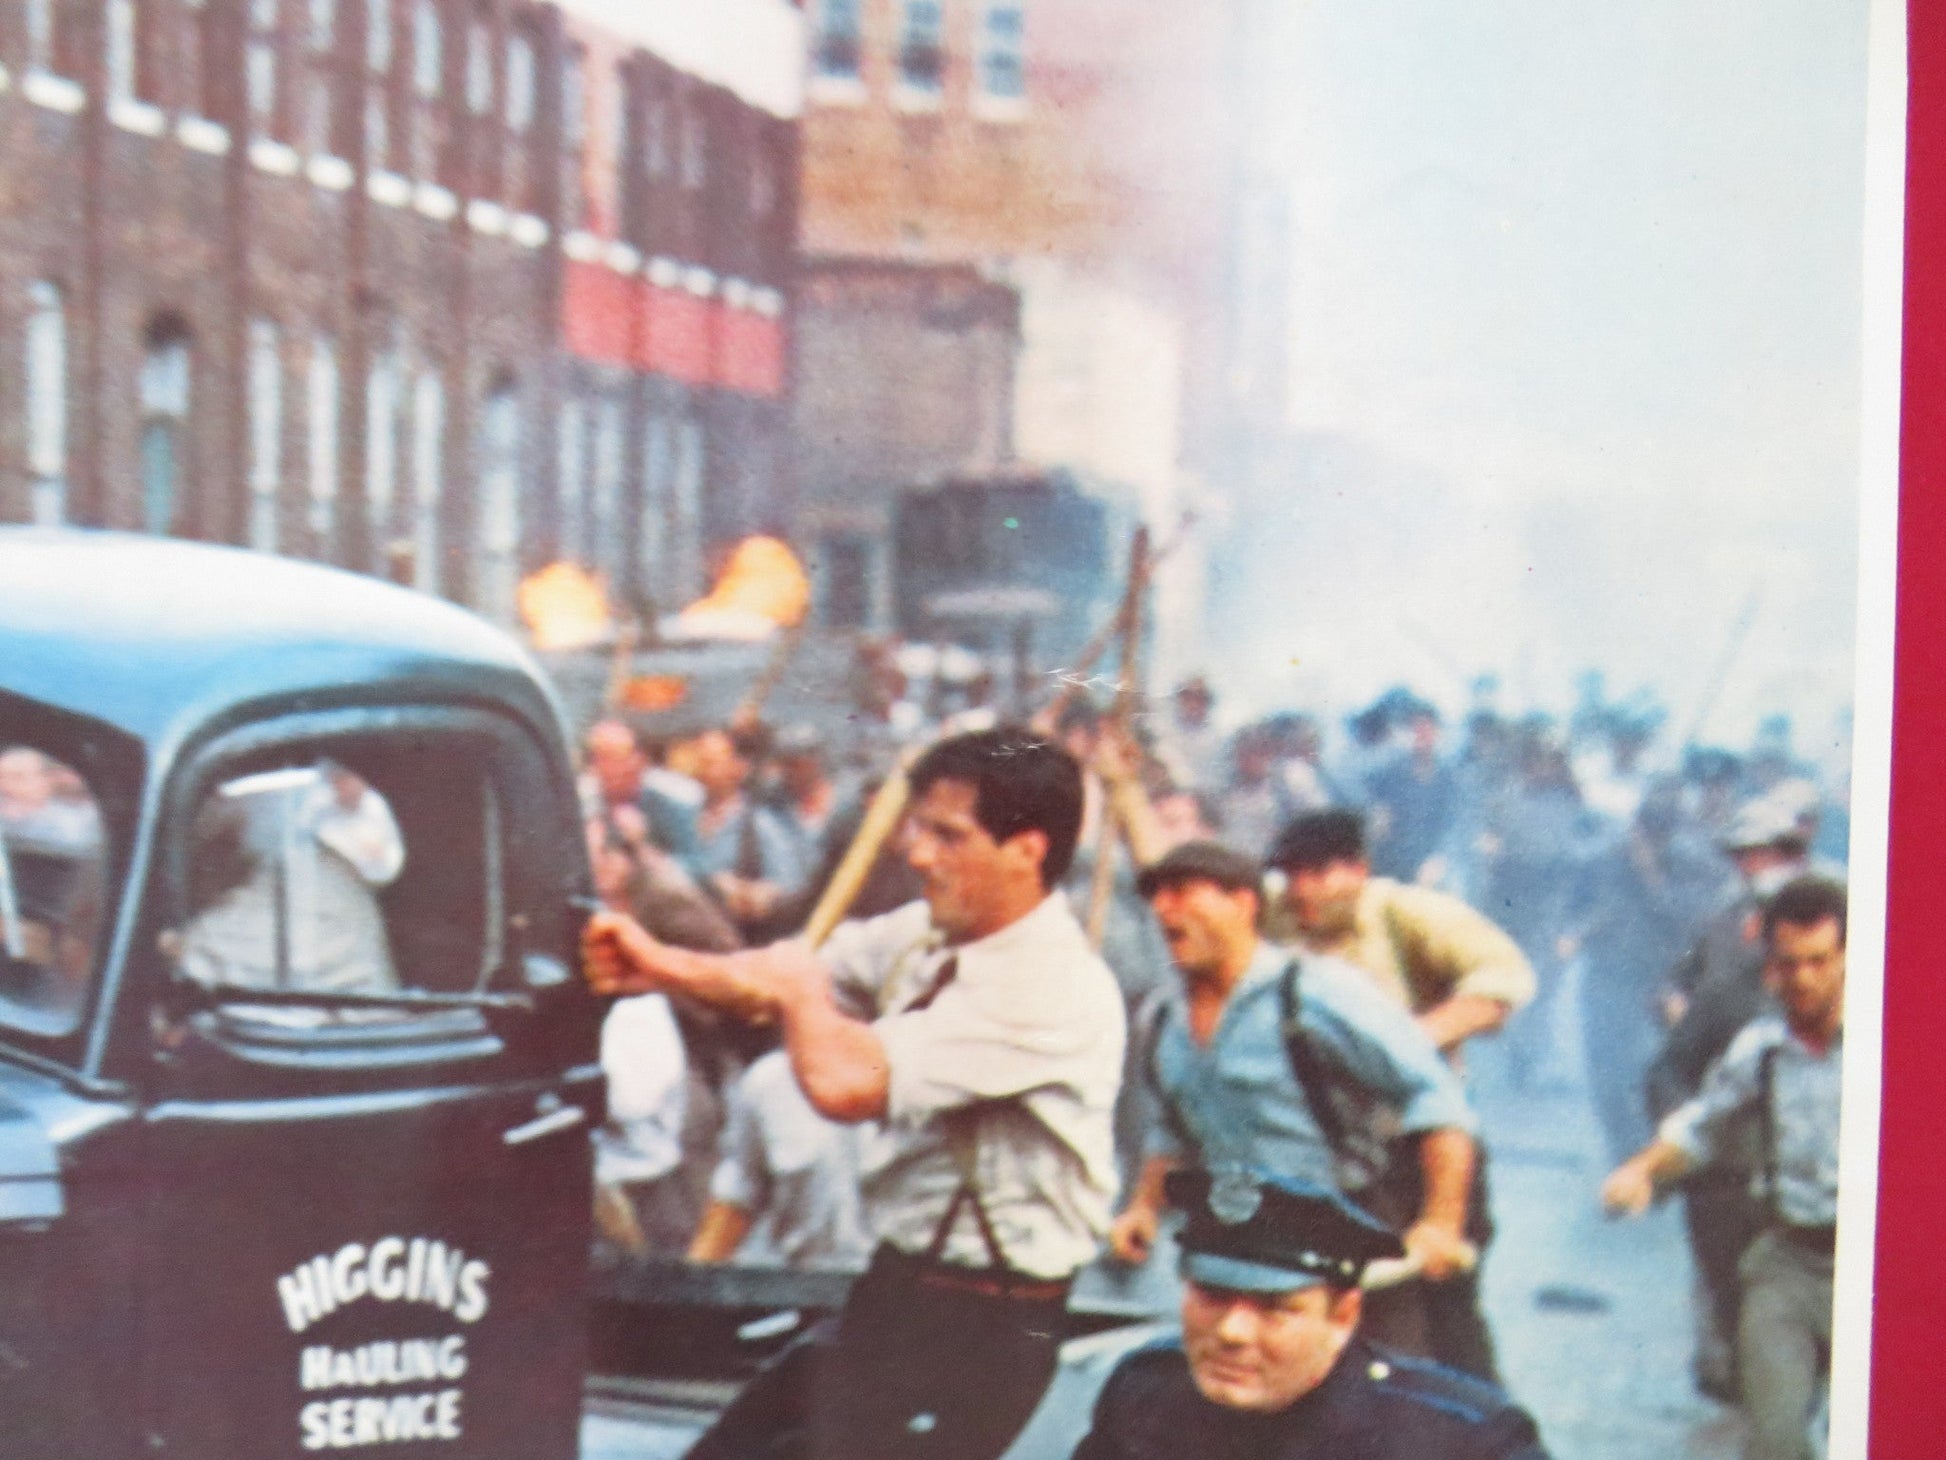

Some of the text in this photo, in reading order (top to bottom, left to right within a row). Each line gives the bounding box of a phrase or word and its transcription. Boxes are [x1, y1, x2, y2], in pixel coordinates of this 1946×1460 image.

[277, 1235, 490, 1333] HIGGINS
[300, 1334, 468, 1391] HAULING
[300, 1389, 463, 1450] SERVICE
